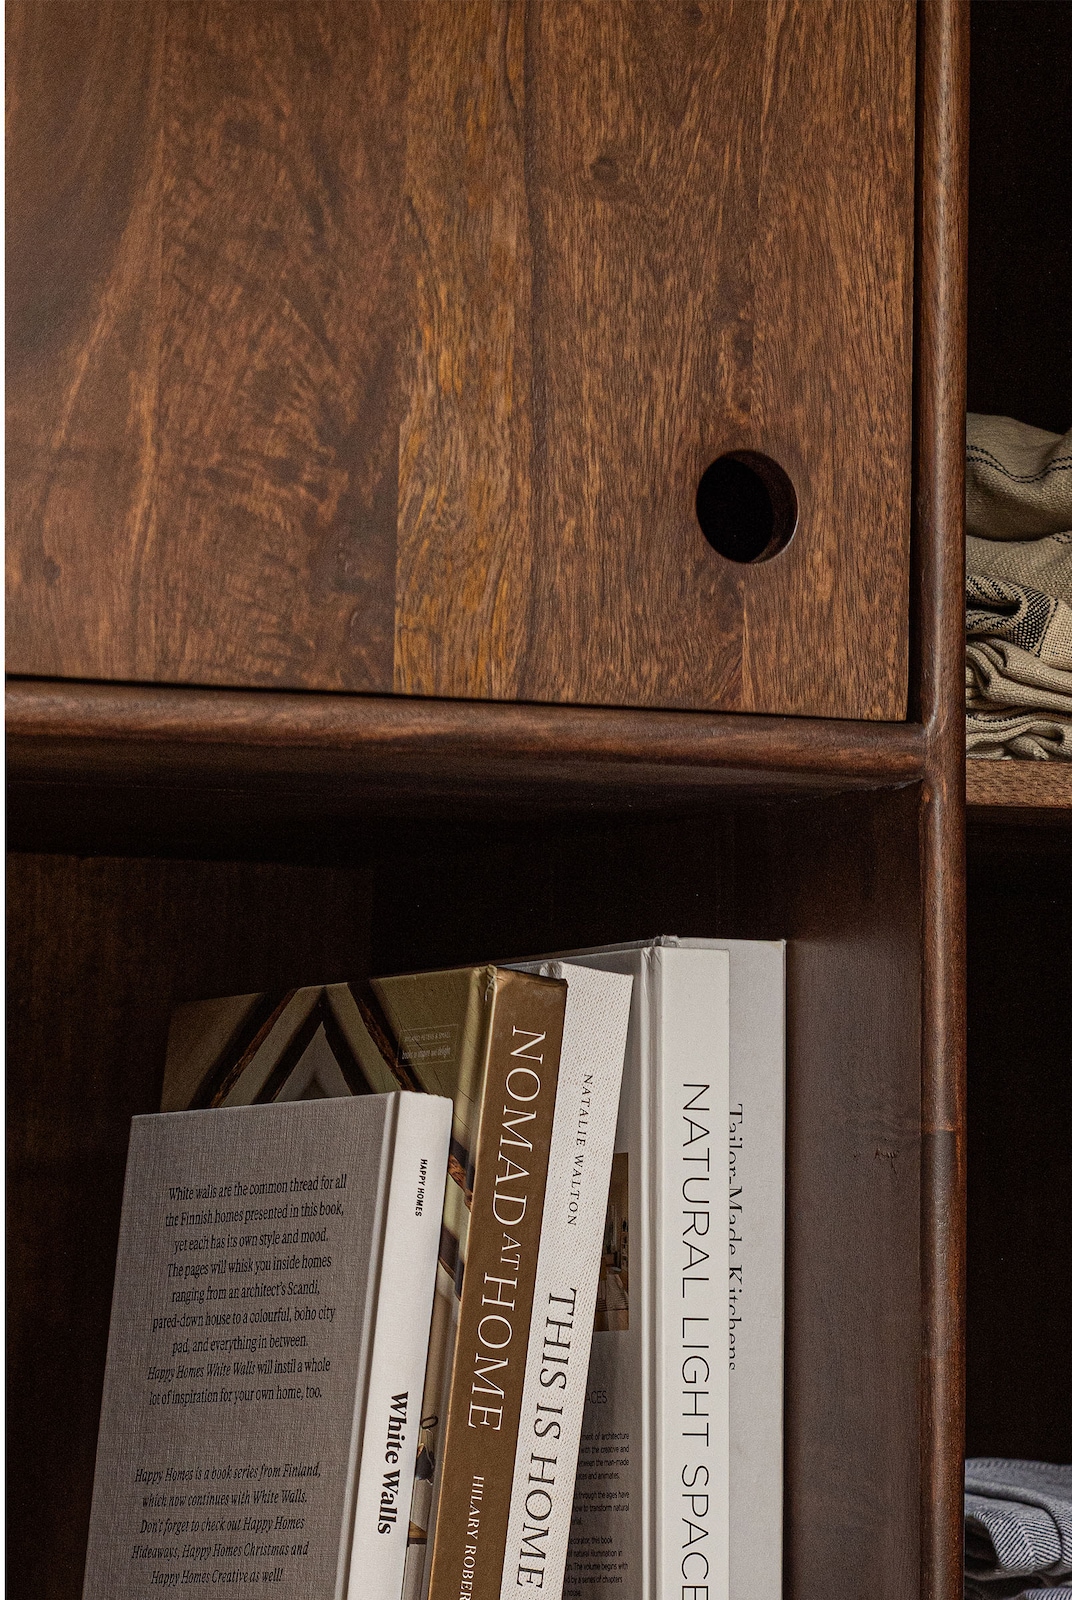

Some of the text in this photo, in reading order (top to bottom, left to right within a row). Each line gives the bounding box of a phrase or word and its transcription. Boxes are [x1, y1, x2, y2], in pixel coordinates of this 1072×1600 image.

[568, 1074, 593, 1226] NATALIE WALTON
[169, 1174, 346, 1200] White walls are the common thread for all
[415, 1159, 428, 1216] HAPPY HOMES
[682, 1083, 710, 1298] NATURAL
[166, 1213, 179, 1226] the
[181, 1210, 213, 1225] Finnish
[215, 1209, 243, 1223] homes
[245, 1205, 287, 1224] presented
[290, 1205, 299, 1218] in
[301, 1203, 317, 1217] this
[468, 1025, 546, 1430] NOMAD AT HOME
[174, 1238, 187, 1254] yet
[190, 1236, 208, 1250] each
[211, 1235, 225, 1249] has
[227, 1234, 237, 1247] its
[239, 1234, 257, 1246] own
[260, 1230, 280, 1246] style
[282, 1229, 299, 1244] and
[168, 1254, 331, 1279] The pages will whisk you inside homes
[172, 1288, 204, 1304] ranging
[207, 1286, 226, 1300] from
[229, 1288, 239, 1299] an
[153, 1315, 203, 1332] pared-down
[205, 1311, 230, 1325] house
[233, 1311, 241, 1324] to
[243, 1314, 248, 1323] a
[295, 1307, 316, 1320] boho
[319, 1305, 335, 1322] city
[193, 1338, 208, 1352] and
[211, 1335, 257, 1354] everything
[259, 1335, 267, 1348] in
[147, 1358, 330, 1382] Happy Homes White Walls will instil a whole
[682, 1317, 710, 1446] LIGHT
[150, 1392, 160, 1405] lot
[162, 1391, 171, 1405] of
[172, 1388, 218, 1406] inspiration
[220, 1388, 232, 1402] for
[234, 1388, 254, 1404] your
[256, 1388, 273, 1400] own
[586, 1391, 607, 1403] ACES
[517, 1287, 577, 1588] THIS IS HOME
[135, 1469, 163, 1484] Happy
[165, 1468, 193, 1481] Homes
[195, 1467, 202, 1480] is
[204, 1469, 209, 1480] a
[212, 1465, 231, 1480] book
[234, 1467, 257, 1479] series
[258, 1464, 281, 1481] from
[378, 1392, 408, 1534] White Walls
[142, 1494, 167, 1508] which
[170, 1496, 186, 1506] now
[188, 1492, 229, 1505] continues
[231, 1491, 250, 1505] with
[253, 1490, 278, 1504] White
[467, 1475, 484, 1540] HILARY
[164, 1518, 189, 1535] forget
[192, 1520, 199, 1531] to
[202, 1517, 224, 1532] check
[227, 1519, 241, 1530] out
[243, 1516, 274, 1533] Happy
[274, 1516, 305, 1529] Homes
[182, 1544, 211, 1560] Happy
[212, 1543, 242, 1556] Homes
[244, 1543, 289, 1556] Christmas
[291, 1541, 309, 1555] and
[151, 1571, 180, 1587] Happy
[181, 1570, 210, 1584] Homes
[212, 1569, 247, 1583] Creative
[250, 1571, 260, 1582] as
